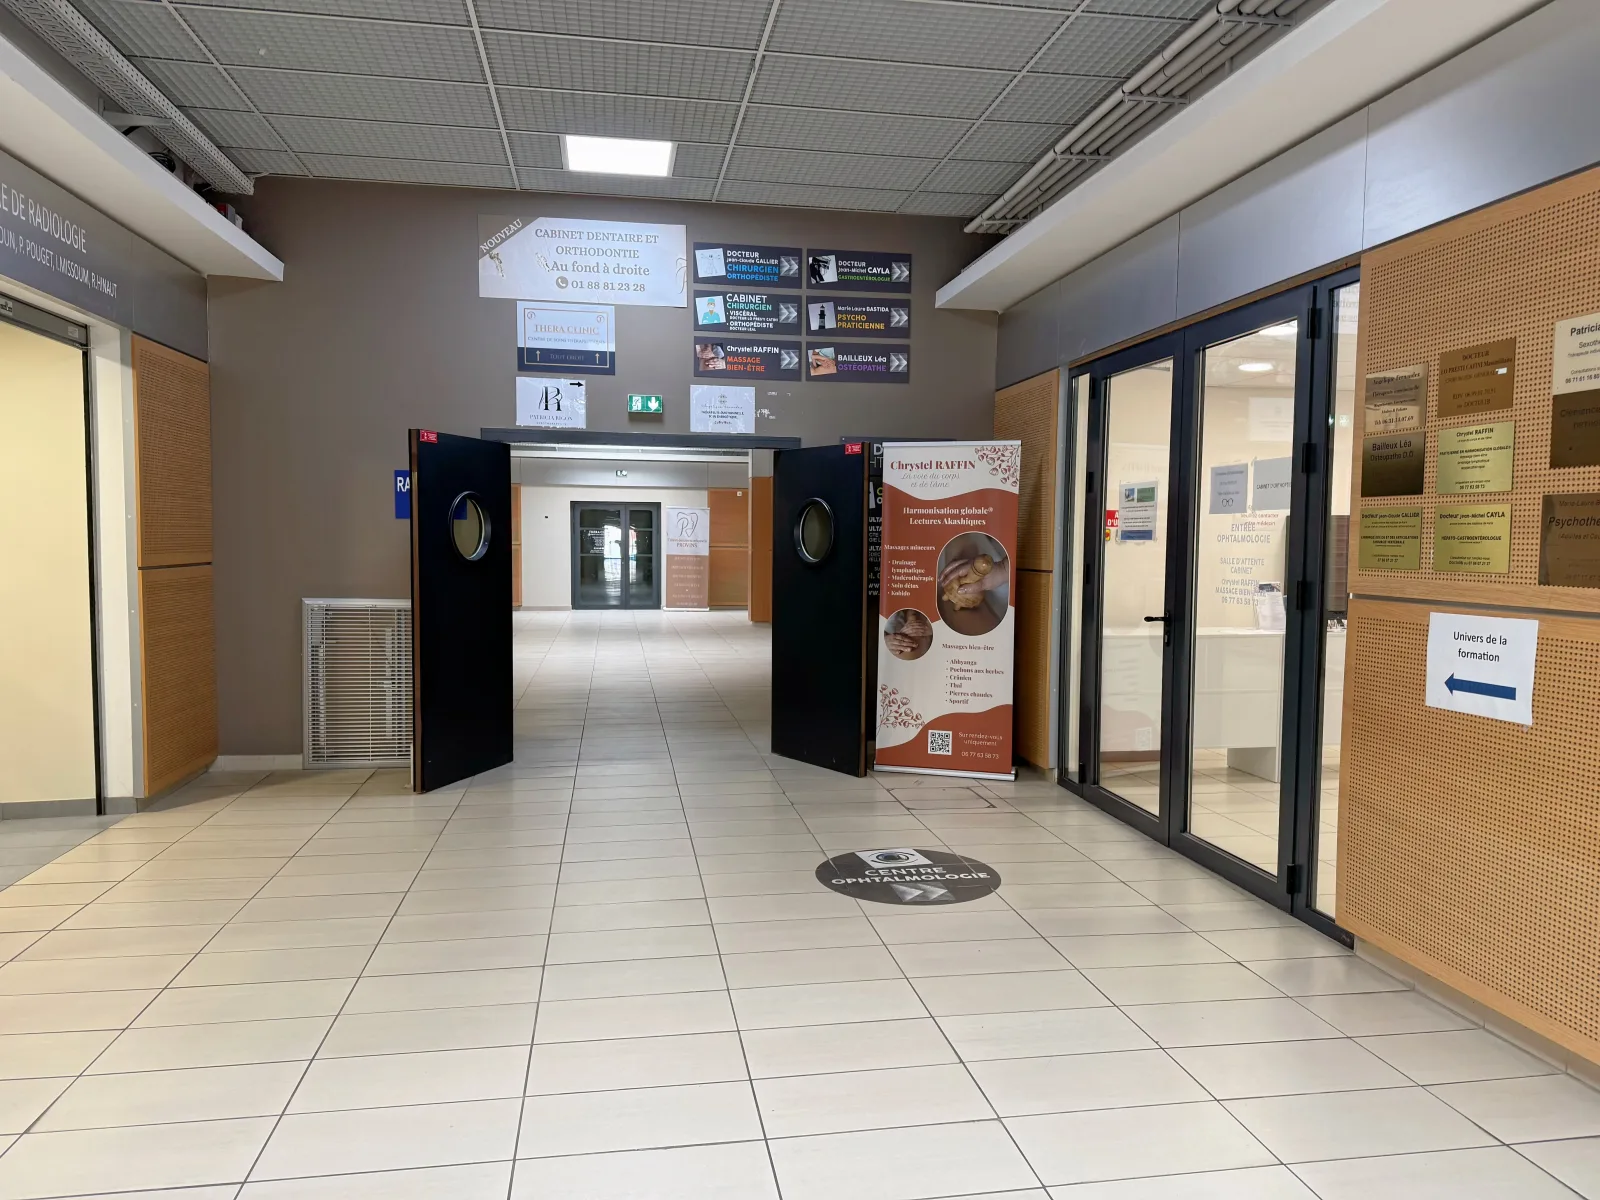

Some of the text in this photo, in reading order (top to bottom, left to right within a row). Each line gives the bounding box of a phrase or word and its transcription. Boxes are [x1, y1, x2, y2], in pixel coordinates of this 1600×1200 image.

[11, 188, 87, 254] DE RADIOLOGIE
[480, 218, 523, 253] NOUVEAU
[535, 228, 659, 243] CABINET DENTAIRE ET
[555, 245, 639, 259] ORTHODONTIE
[726, 250, 760, 258] DOCTEUR
[550, 261, 650, 276] Au fond à droite
[726, 264, 779, 273] CHIRURGIEN
[867, 267, 890, 275] CAYLA
[726, 272, 779, 281] ORTHOPÉDISTE
[571, 280, 646, 292] 01 88 81 23 28
[726, 293, 767, 304] CABINET
[726, 302, 772, 310] CHIRURGIEN
[730, 320, 774, 328] ORTHOPÉDISTE
[837, 321, 885, 329] PRATICIENNE
[726, 345, 752, 354] Chrystel
[726, 355, 761, 363] MASSAGE
[838, 354, 873, 362] BAILLEUX
[1462, 350, 1490, 361] DOCTEUR
[726, 363, 765, 372] BIEN-ÊTRE
[837, 362, 887, 372] OSTÉOPATHE
[1372, 439, 1412, 452] Bailleux Léa
[890, 459, 933, 472] Chrystel
[935, 459, 976, 470] RAFFIN
[903, 506, 959, 515] Harmonisation
[909, 517, 986, 527] Lectures Akashiques
[1217, 534, 1271, 543] OPHTALMOLOGIE
[1220, 557, 1265, 566] SALLE D'ATTENTE
[1231, 566, 1253, 575] CABINET
[1215, 586, 1238, 595] MASSAGE
[1453, 631, 1508, 646] Univers de la
[942, 643, 967, 651] Massages
[1458, 648, 1500, 662] formation
[963, 739, 998, 747] uniquement
[865, 867, 947, 876] CENTRE
[831, 871, 991, 885] OPHTALMOLOGIE
